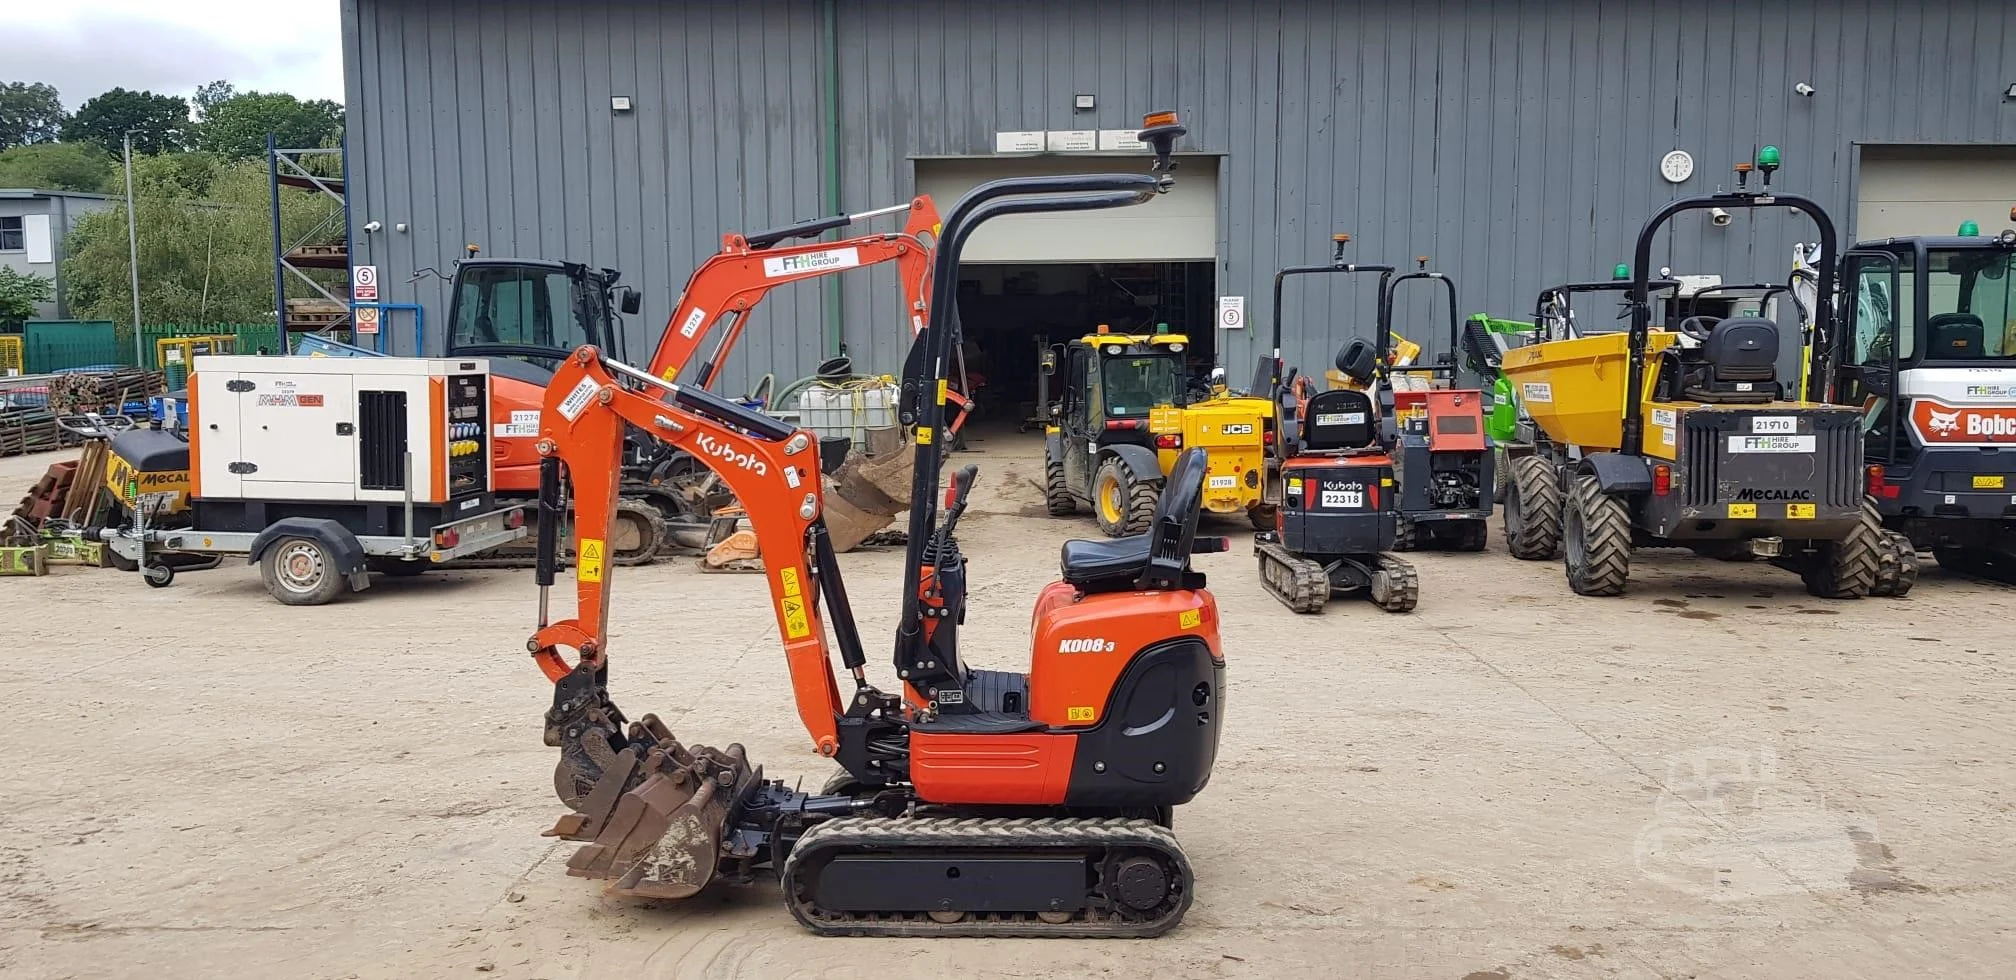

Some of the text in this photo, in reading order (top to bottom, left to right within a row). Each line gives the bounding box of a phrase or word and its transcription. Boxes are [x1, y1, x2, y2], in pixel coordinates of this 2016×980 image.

[811, 252, 828, 260] HIRE
[783, 256, 810, 270] FTH
[811, 257, 839, 267] GROUP
[362, 271, 369, 281] 5
[1229, 312, 1234, 320] 5
[565, 383, 587, 406] WHITES
[513, 414, 539, 422] 21274
[1222, 424, 1252, 434] JCB
[1744, 437, 1771, 449] FTH
[695, 432, 767, 476] Kubota
[1323, 480, 1363, 491] Kubota
[1325, 494, 1360, 504] 22318
[1058, 638, 1115, 653] K008-3
